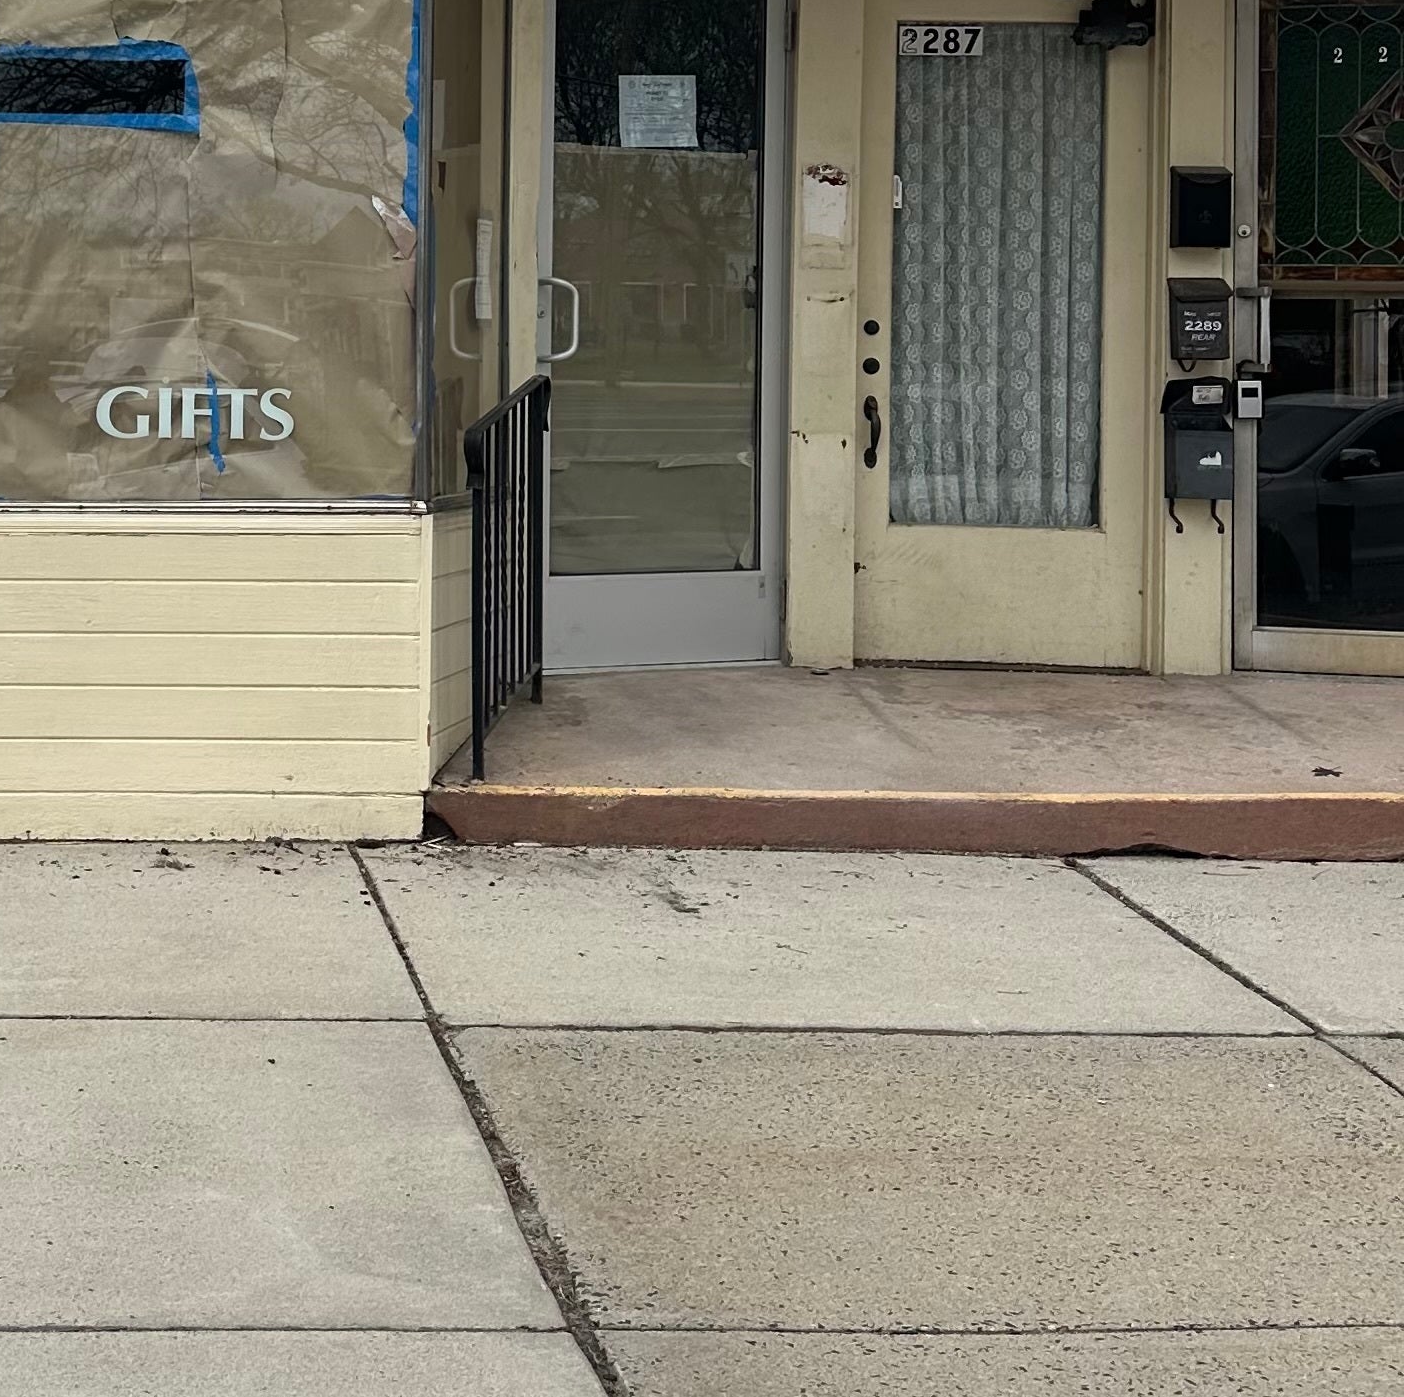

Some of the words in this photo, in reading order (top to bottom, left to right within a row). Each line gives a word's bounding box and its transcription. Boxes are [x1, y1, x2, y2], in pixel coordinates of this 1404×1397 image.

[901, 28, 981, 54] 2287
[1184, 320, 1222, 331] 2289
[96, 385, 295, 441] GIFTS
